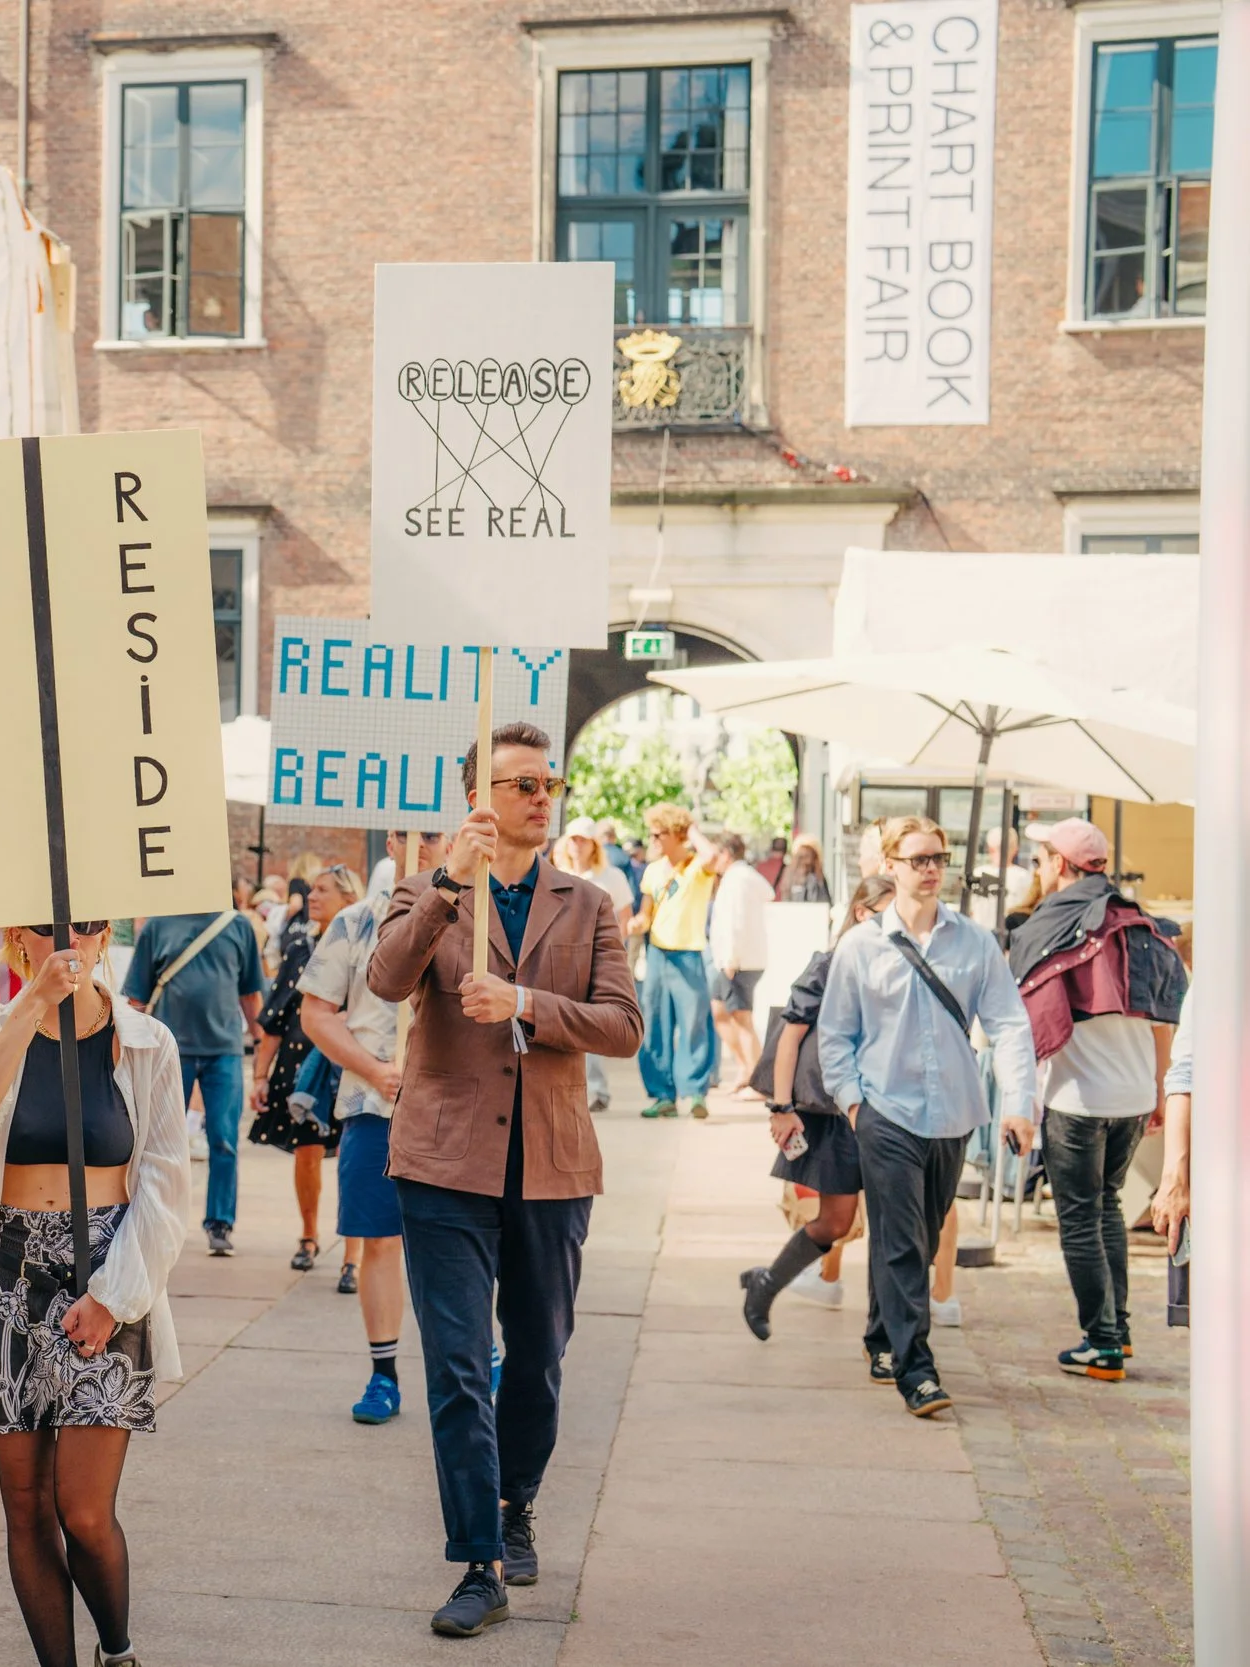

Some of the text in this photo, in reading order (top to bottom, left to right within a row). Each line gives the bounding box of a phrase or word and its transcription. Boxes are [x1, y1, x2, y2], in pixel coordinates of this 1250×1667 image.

[864, 20, 914, 362] & PRINT FAIR
[926, 16, 979, 409] CHART BOOK
[405, 367, 582, 398] RELEASE
[404, 507, 576, 538] SEE REAL
[279, 636, 562, 705] REALITY
